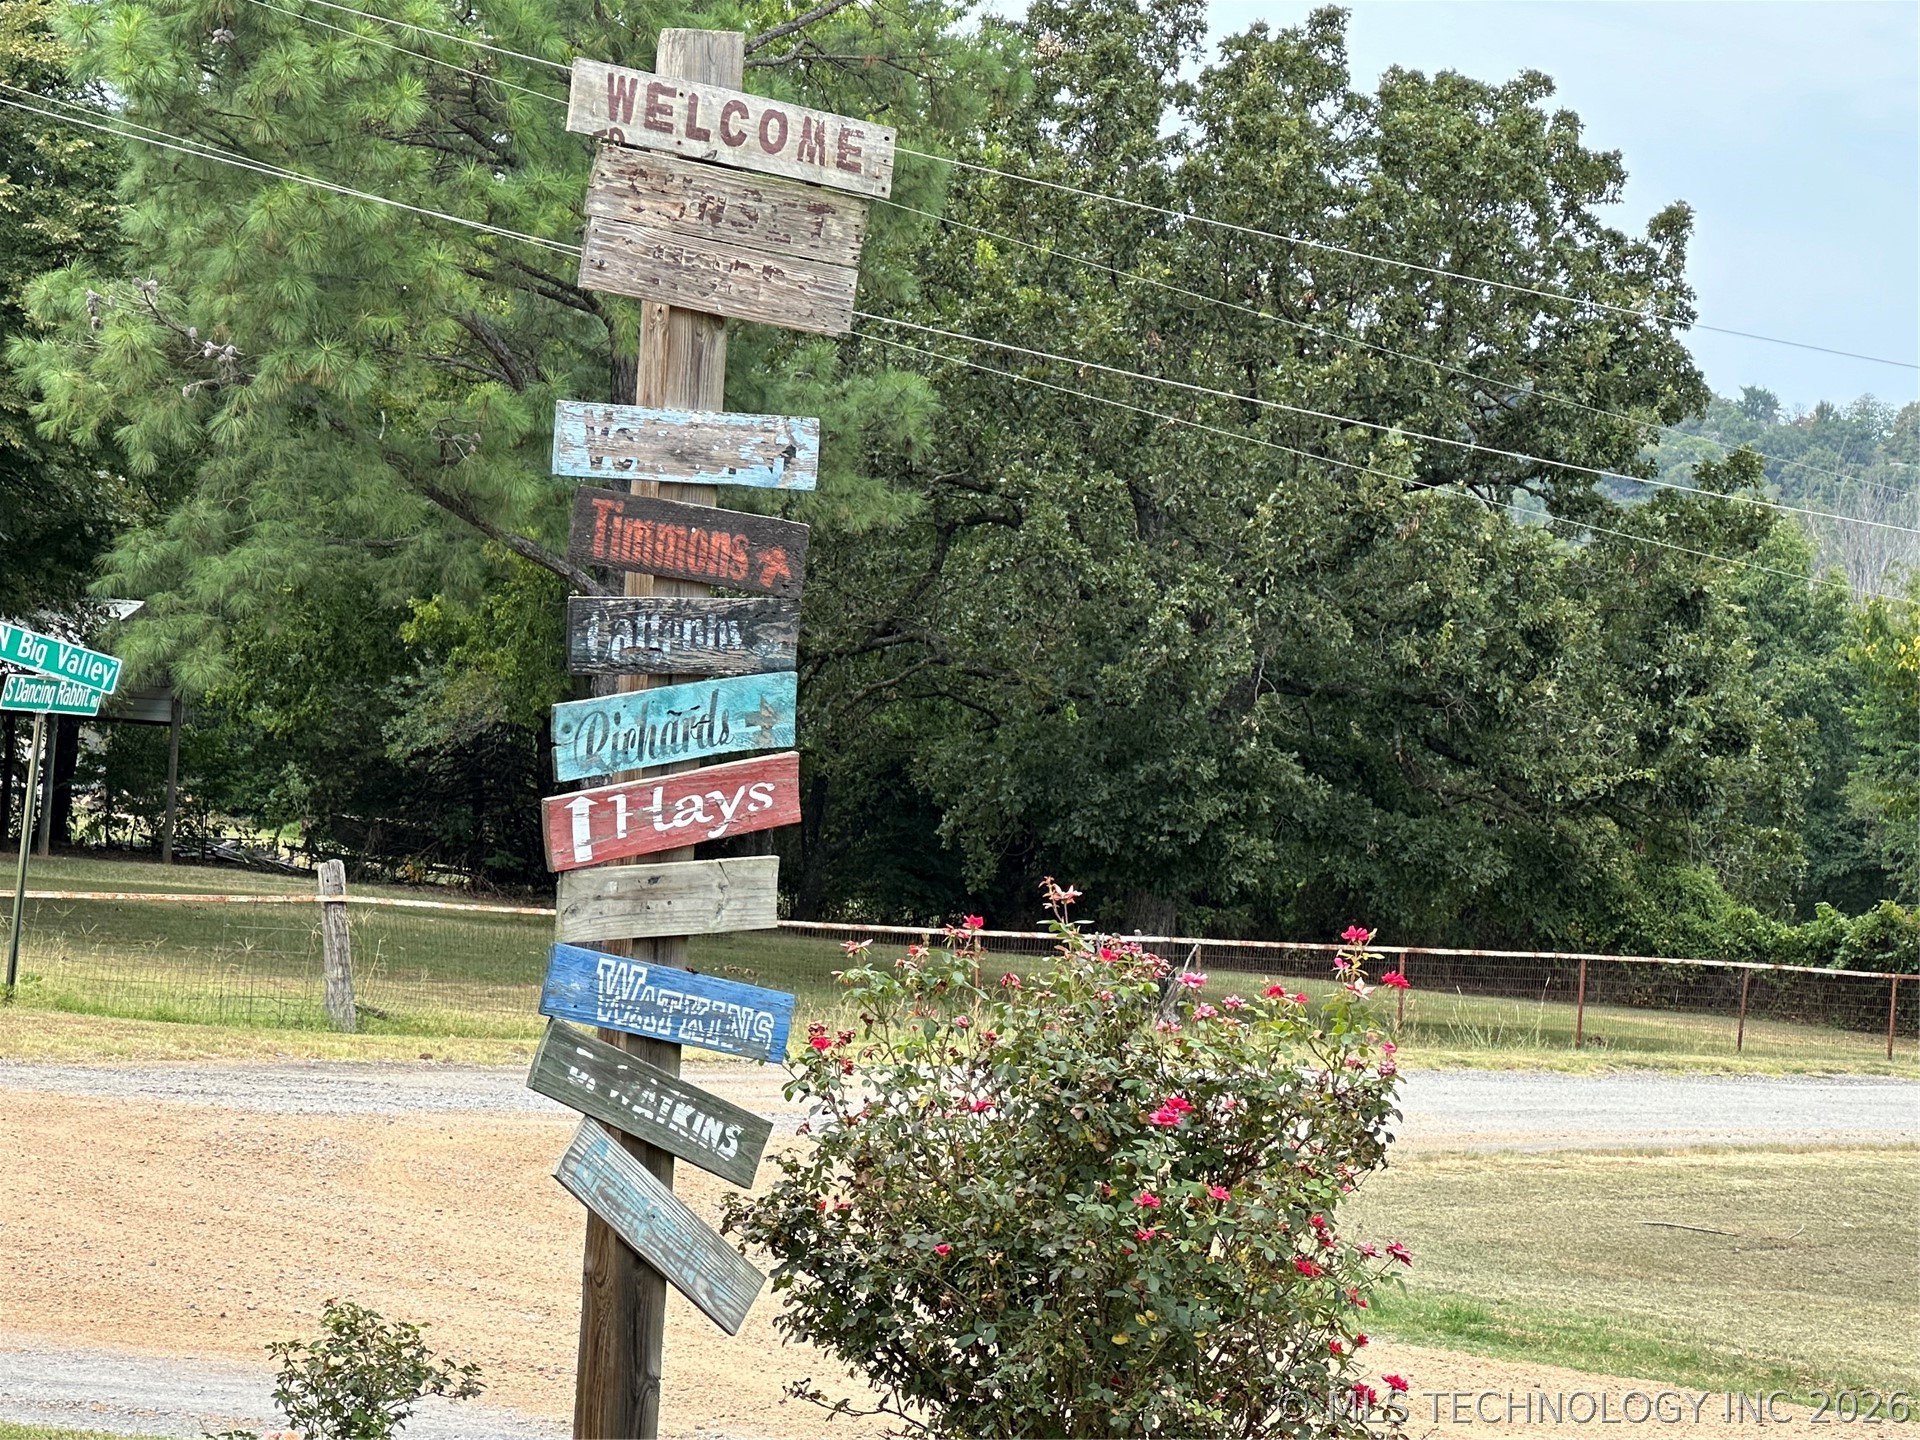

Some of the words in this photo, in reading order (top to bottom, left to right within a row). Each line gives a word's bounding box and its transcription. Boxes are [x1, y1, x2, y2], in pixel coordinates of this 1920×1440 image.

[607, 72, 866, 174] WELCOME
[592, 497, 749, 581] Timmons
[0, 626, 12, 652] N
[17, 631, 49, 668] Big
[58, 644, 117, 689] Valley
[5, 677, 16, 702] S
[14, 678, 57, 710] Dancing
[55, 681, 92, 707] Rabbit
[574, 688, 736, 775] Richards
[607, 782, 776, 838] Hays
